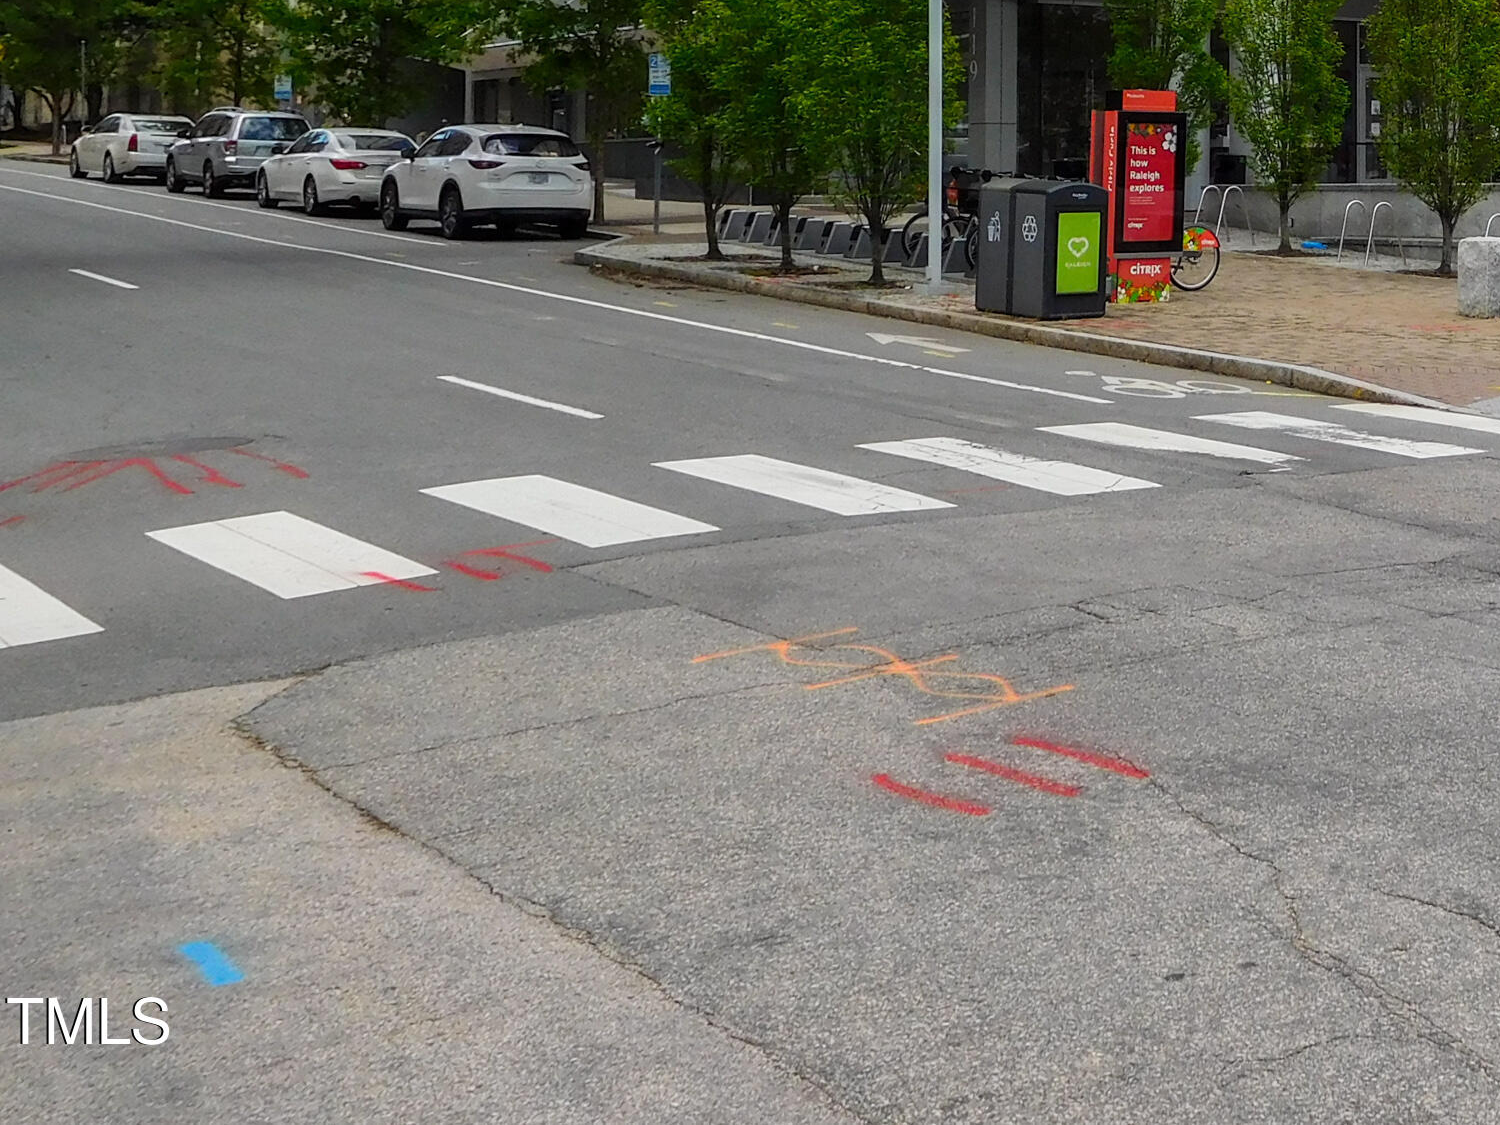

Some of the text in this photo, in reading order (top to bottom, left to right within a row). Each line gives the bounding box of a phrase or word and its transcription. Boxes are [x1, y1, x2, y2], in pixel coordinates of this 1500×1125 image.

[1131, 146, 1156, 155] This is
[1130, 158, 1149, 168] how
[1129, 171, 1161, 182] Raleigh
[1129, 184, 1165, 194] explores
